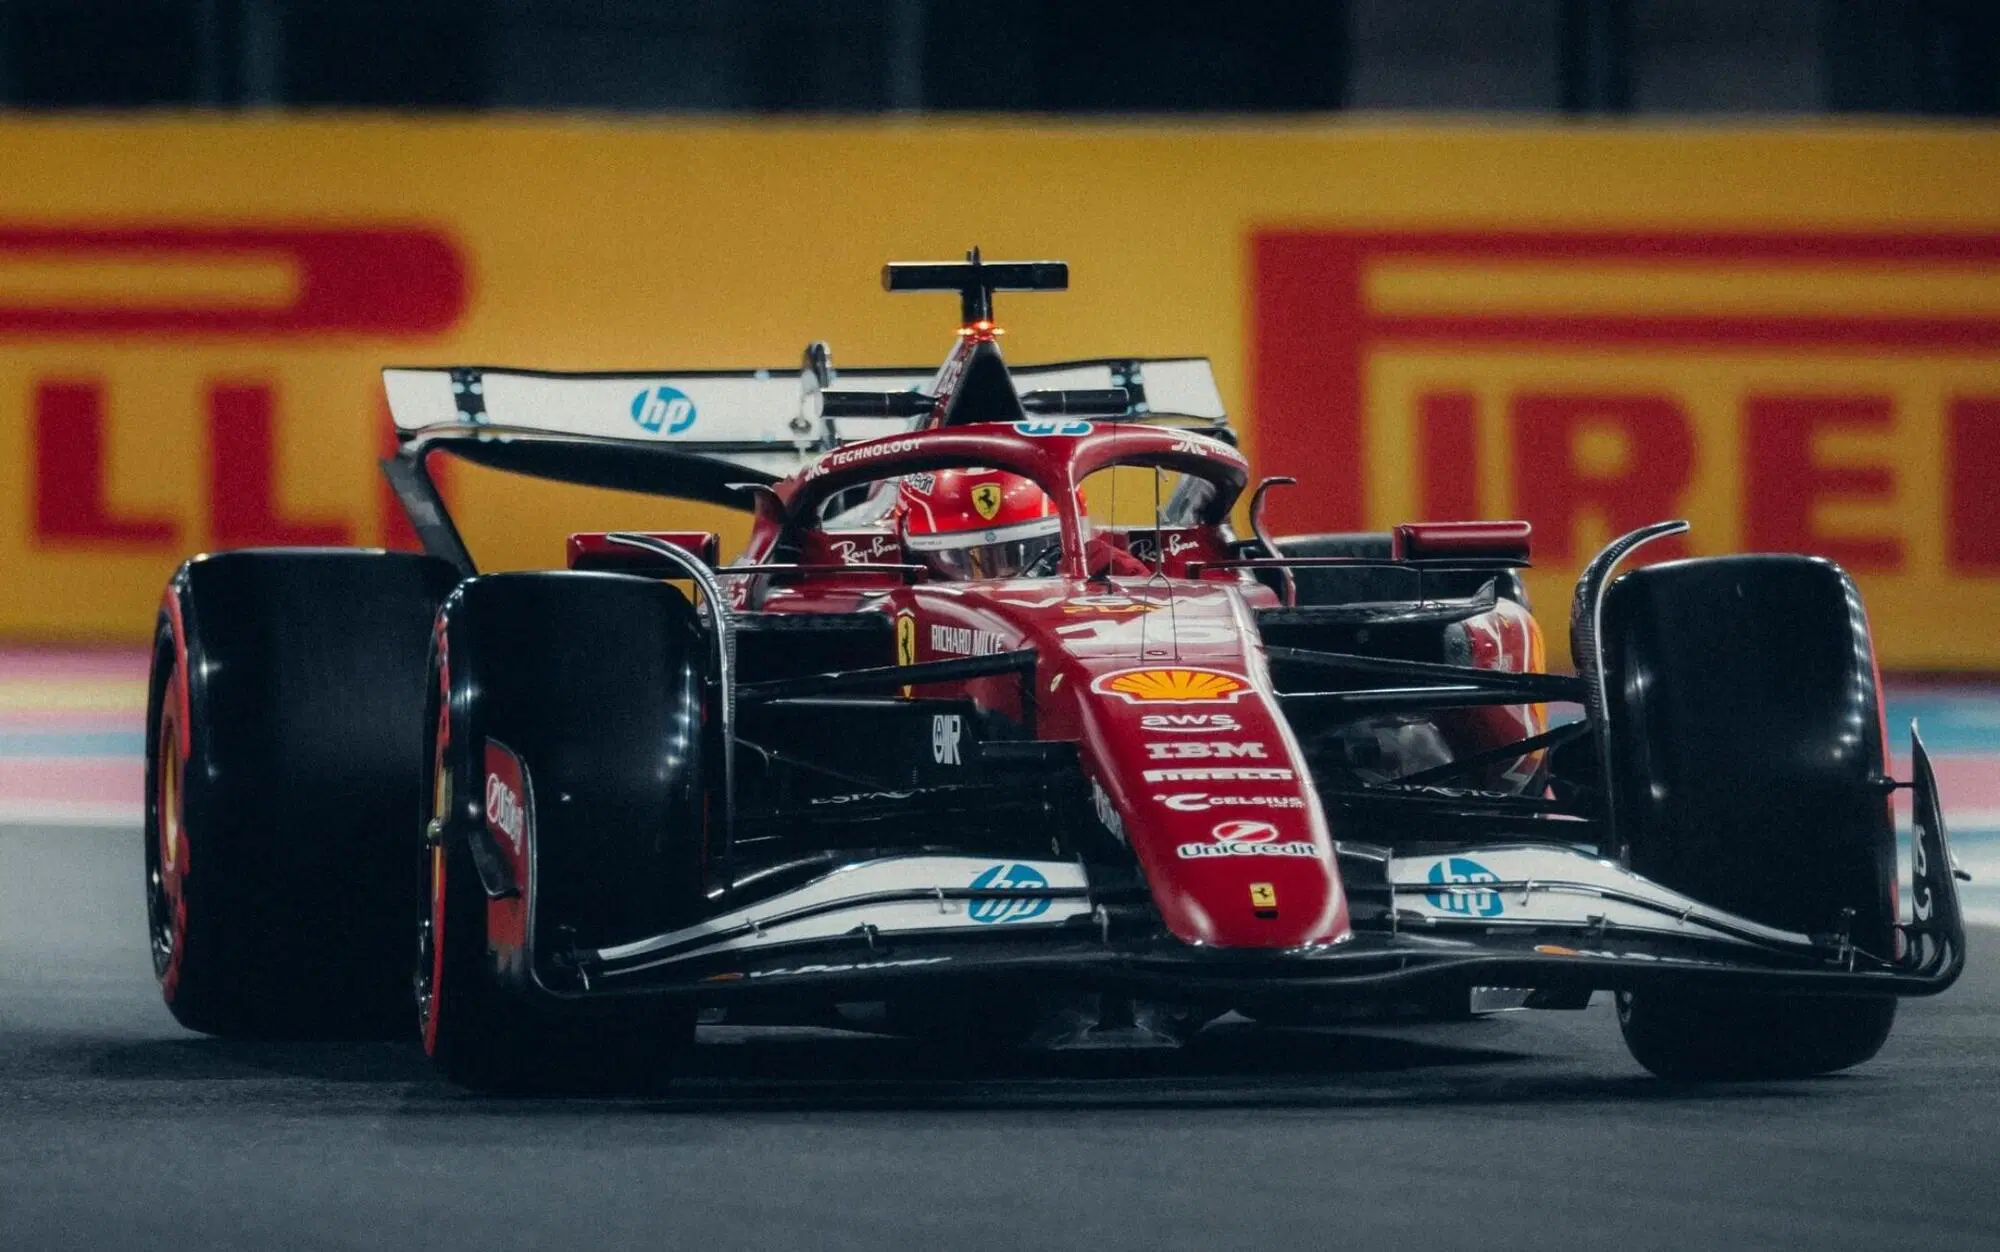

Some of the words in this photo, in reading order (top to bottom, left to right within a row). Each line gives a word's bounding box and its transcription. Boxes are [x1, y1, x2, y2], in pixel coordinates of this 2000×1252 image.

[631, 386, 697, 434] hp
[832, 438, 921, 467] TECHNOLOGY
[830, 536, 901, 565] Ray-Ban
[931, 624, 972, 655] RICHARD
[973, 629, 1006, 656] MILLE
[1140, 714, 1238, 727] aws
[1144, 741, 1269, 759] IBM
[1142, 767, 1294, 783] PIRELLI
[1178, 842, 1316, 859] UniCredit
[968, 863, 1050, 923] hp
[1427, 858, 1503, 917] hp
